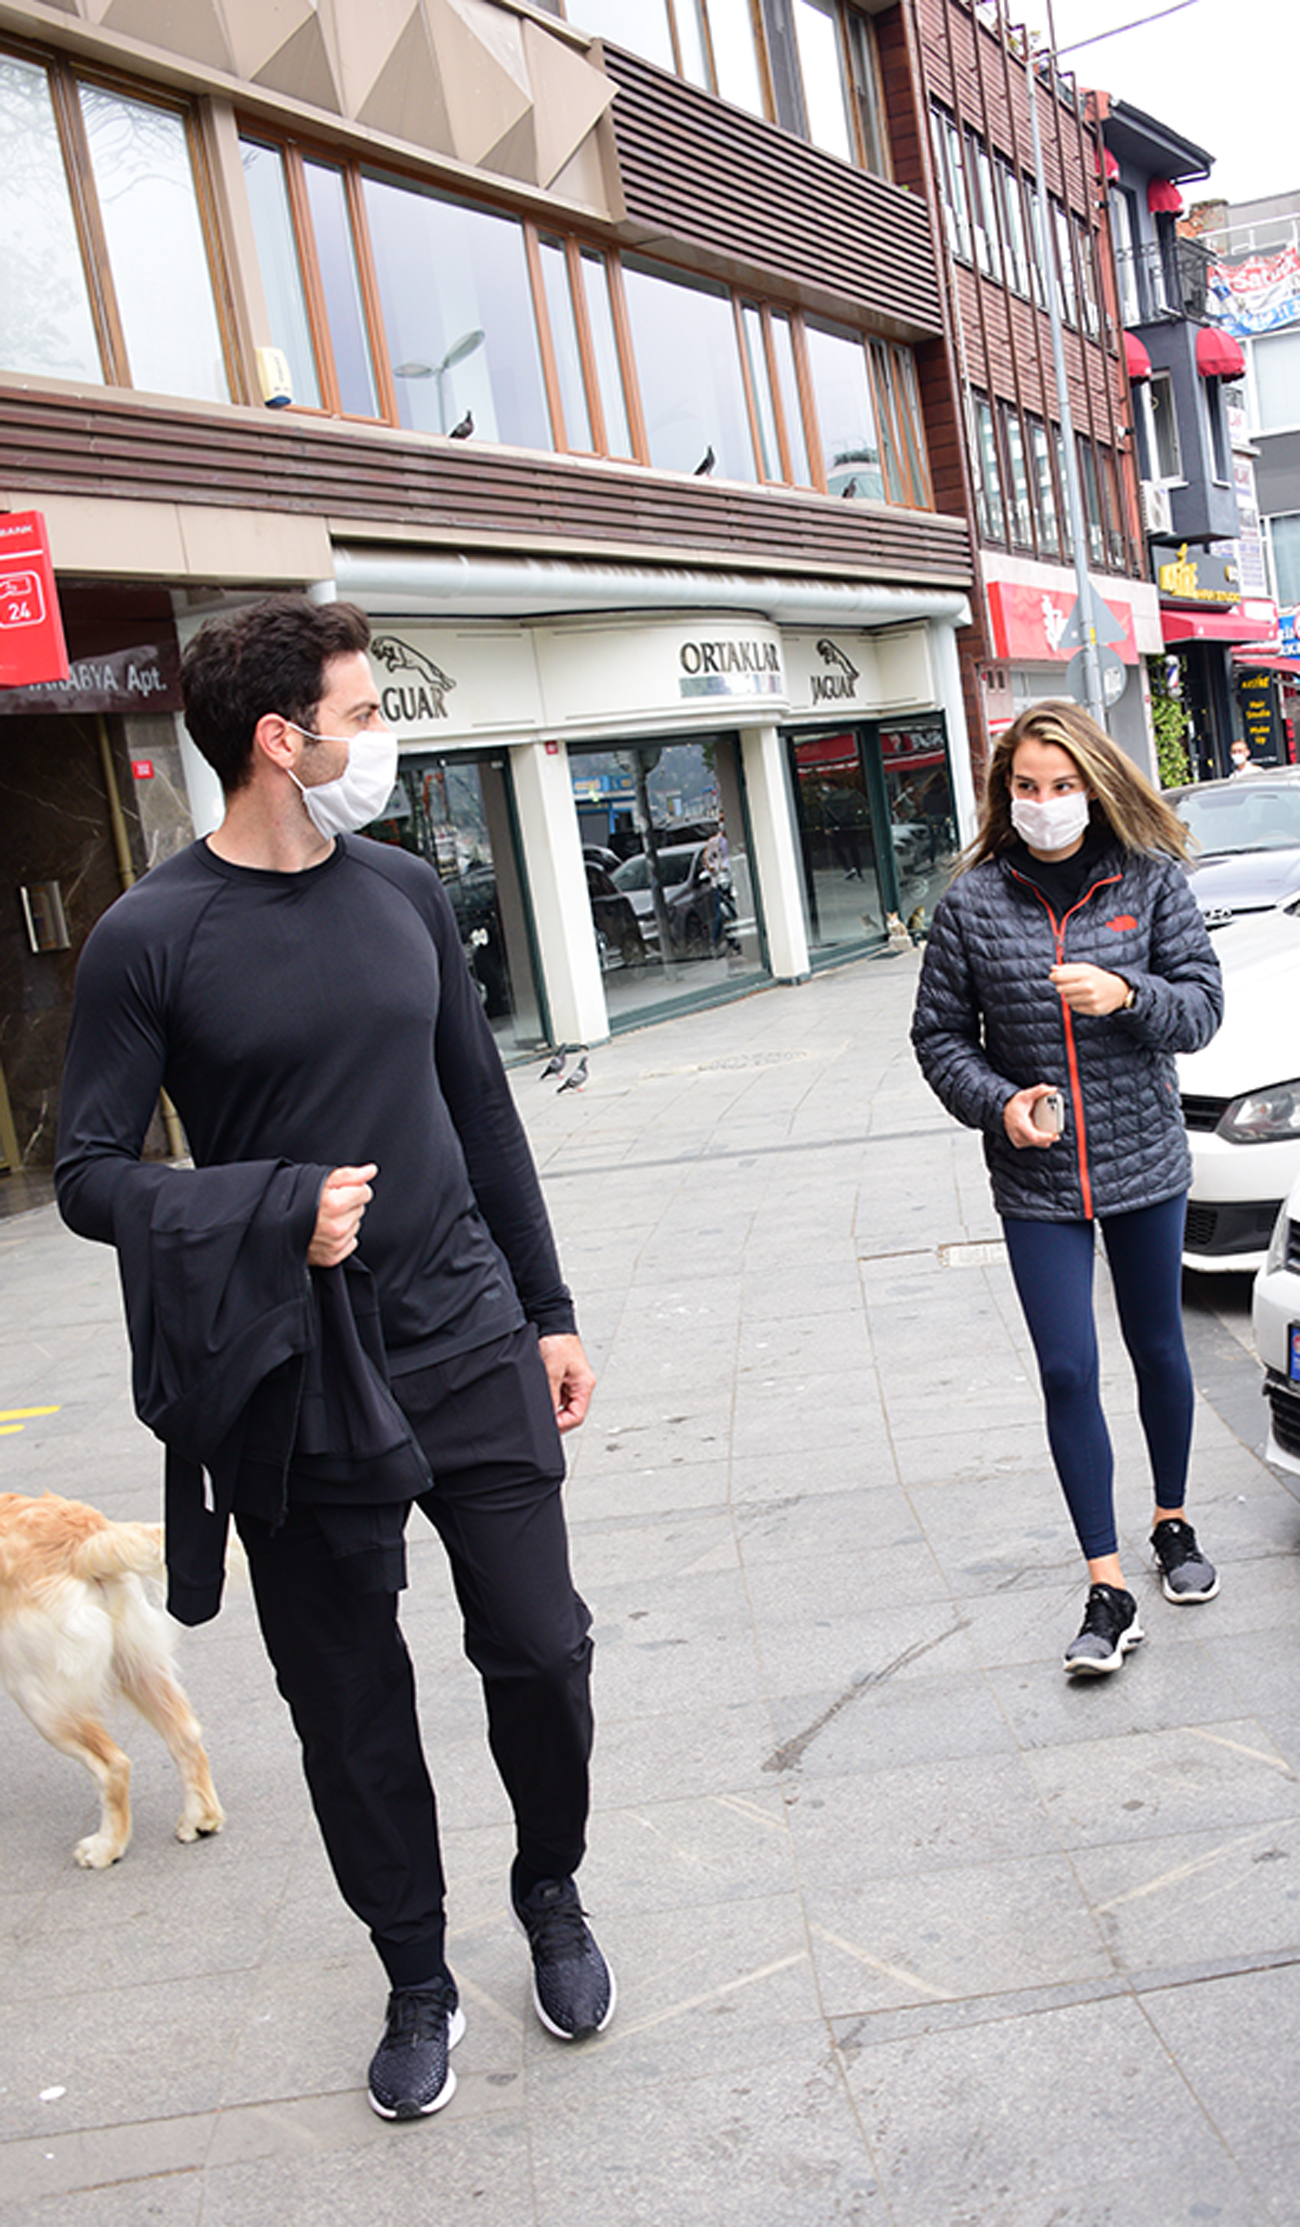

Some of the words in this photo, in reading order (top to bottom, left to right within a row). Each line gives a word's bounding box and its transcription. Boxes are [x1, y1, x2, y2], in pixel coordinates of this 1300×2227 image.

[8, 602, 31, 620] 24
[681, 642, 780, 674] ORTAKLAR
[30, 664, 119, 691] ABYA
[127, 664, 167, 697] Apt.
[811, 675, 857, 706] JAGUAR
[379, 686, 448, 721] GUAR
